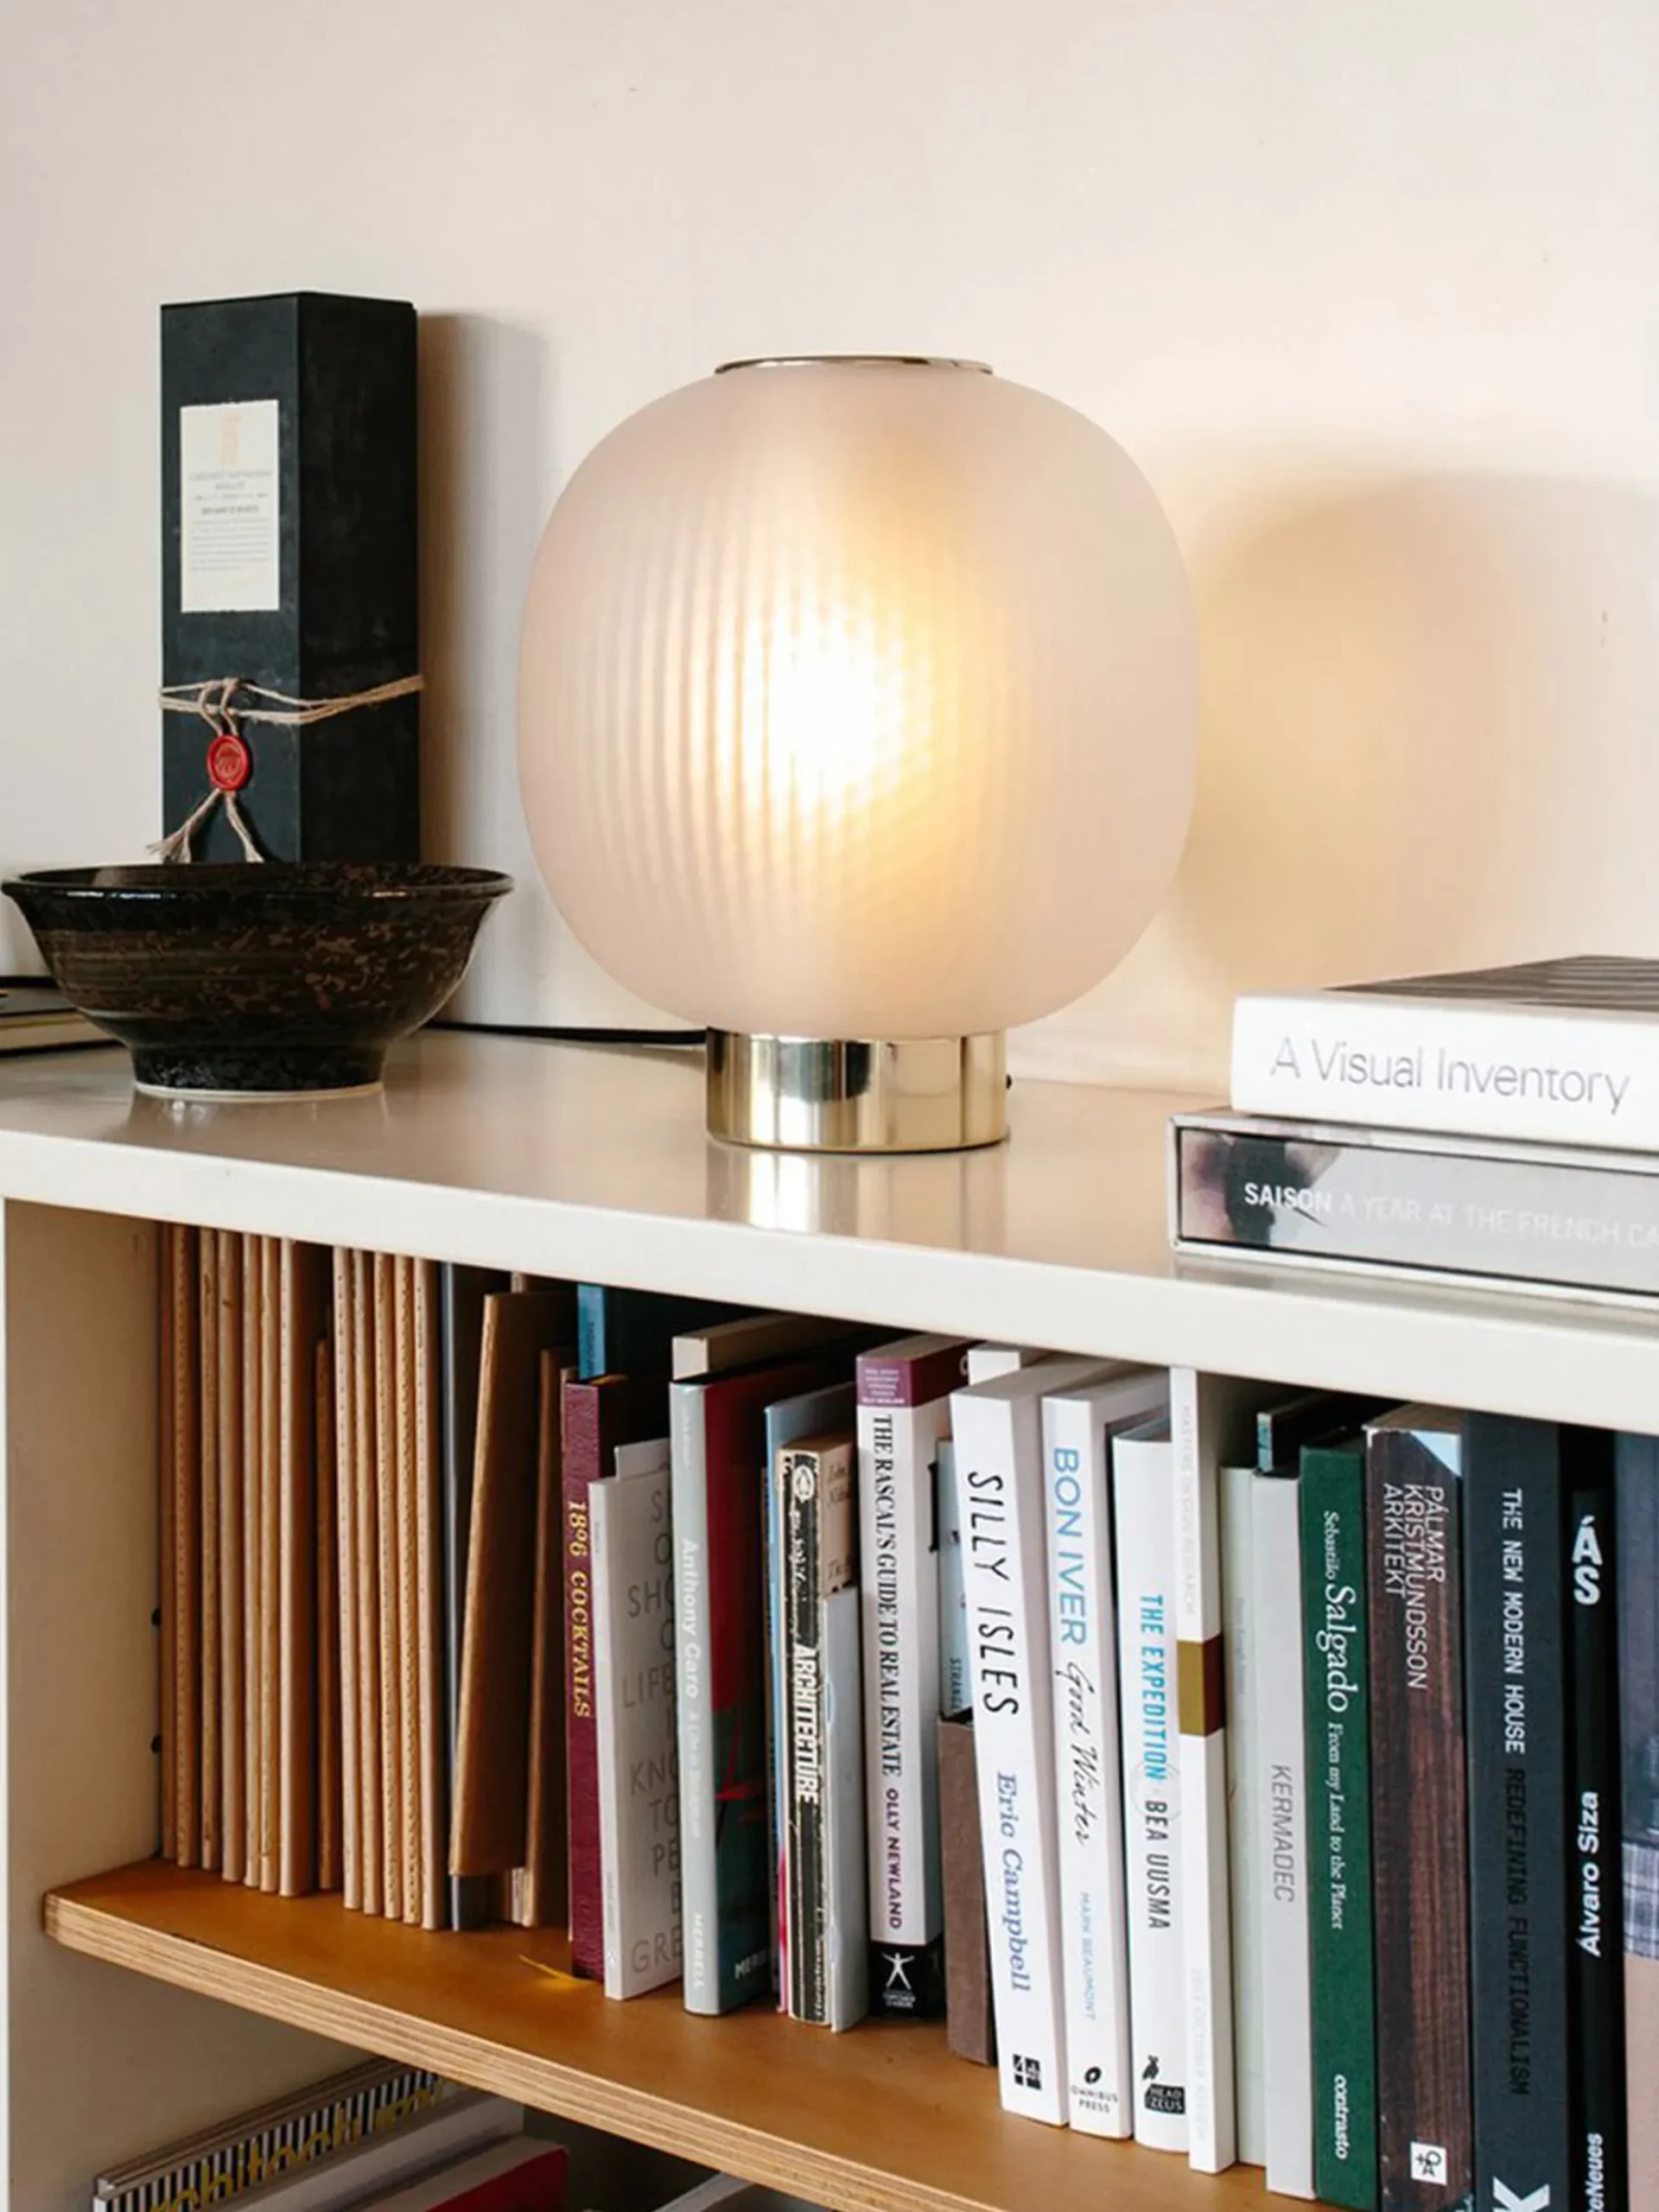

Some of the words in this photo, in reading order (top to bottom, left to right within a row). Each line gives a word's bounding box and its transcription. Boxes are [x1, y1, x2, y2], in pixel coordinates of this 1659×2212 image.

[1270, 1037, 1300, 1079] A
[1311, 1039, 1422, 1089] Visual
[1437, 1048, 1630, 1115] Inventory
[1244, 1182, 1332, 1212] SAISON
[1341, 1195, 1361, 1217] A
[1363, 1197, 1422, 1222] YEAR
[1428, 1202, 1457, 1225] AT
[1464, 1204, 1512, 1234] THE
[1519, 1211, 1619, 1244] FRENCH
[873, 1414, 893, 1454] THE
[874, 1459, 897, 1551] RASCAL'S
[967, 1471, 1011, 1582] SILLY
[1054, 1447, 1084, 1538] BON
[1502, 1488, 1523, 1530] THE
[1383, 1483, 1407, 1599] ARKITEKT
[1425, 1484, 1449, 1583] PÁLMAR
[1503, 1541, 1524, 1583] NEW
[682, 1538, 700, 1637] Anthony
[876, 1554, 899, 1616] GUIDE
[1058, 1551, 1087, 1646] IVER
[1140, 1594, 1165, 1636] THE
[1403, 1483, 1428, 1690] KRISTMUNDSSON
[571, 1571, 590, 1718] COCKTAILS
[683, 1643, 701, 1699] Caro
[878, 1618, 899, 1647] TO
[977, 1606, 1020, 1715] ISLES
[1315, 1584, 1359, 1713] Salgado
[1503, 1592, 1524, 1675] MODERN
[880, 1649, 900, 1706] REAL
[1054, 1662, 1096, 1736] Good
[1141, 1647, 1167, 1782] EXPEDITION
[792, 1643, 820, 1806] ARCHITECTURE
[880, 1707, 902, 1778] ESTATE
[1328, 1722, 1344, 1764] From
[1504, 1684, 1525, 1754] HOUSE
[886, 1788, 900, 1832] OLLY
[997, 1773, 1020, 1838] Eric
[1070, 1744, 1099, 1847] Winter
[1325, 1766, 1340, 1791] my
[1330, 1793, 1345, 1834] Land
[1145, 1800, 1169, 1842] BEA
[1270, 1764, 1295, 1903] KERMADEC
[1330, 1835, 1342, 1853] to
[1506, 1767, 1528, 1905] REDEFINING
[1577, 1791, 1600, 1854] Siza
[887, 1836, 903, 1930] NEWLAND
[1146, 1853, 1172, 1930] UUSMA
[1331, 1855, 1346, 1879] the
[1001, 1849, 1032, 1992] Campbell
[1082, 1937, 1097, 2021] BEAUMONT
[1508, 1916, 1531, 2096] FUNCTIONALISM
[1071, 2084, 1118, 2103] OMNIBUS
[1079, 2098, 1110, 2114] PRESS
[1334, 2074, 1350, 2159] contrasto
[1585, 2133, 1605, 2212] eNeues
